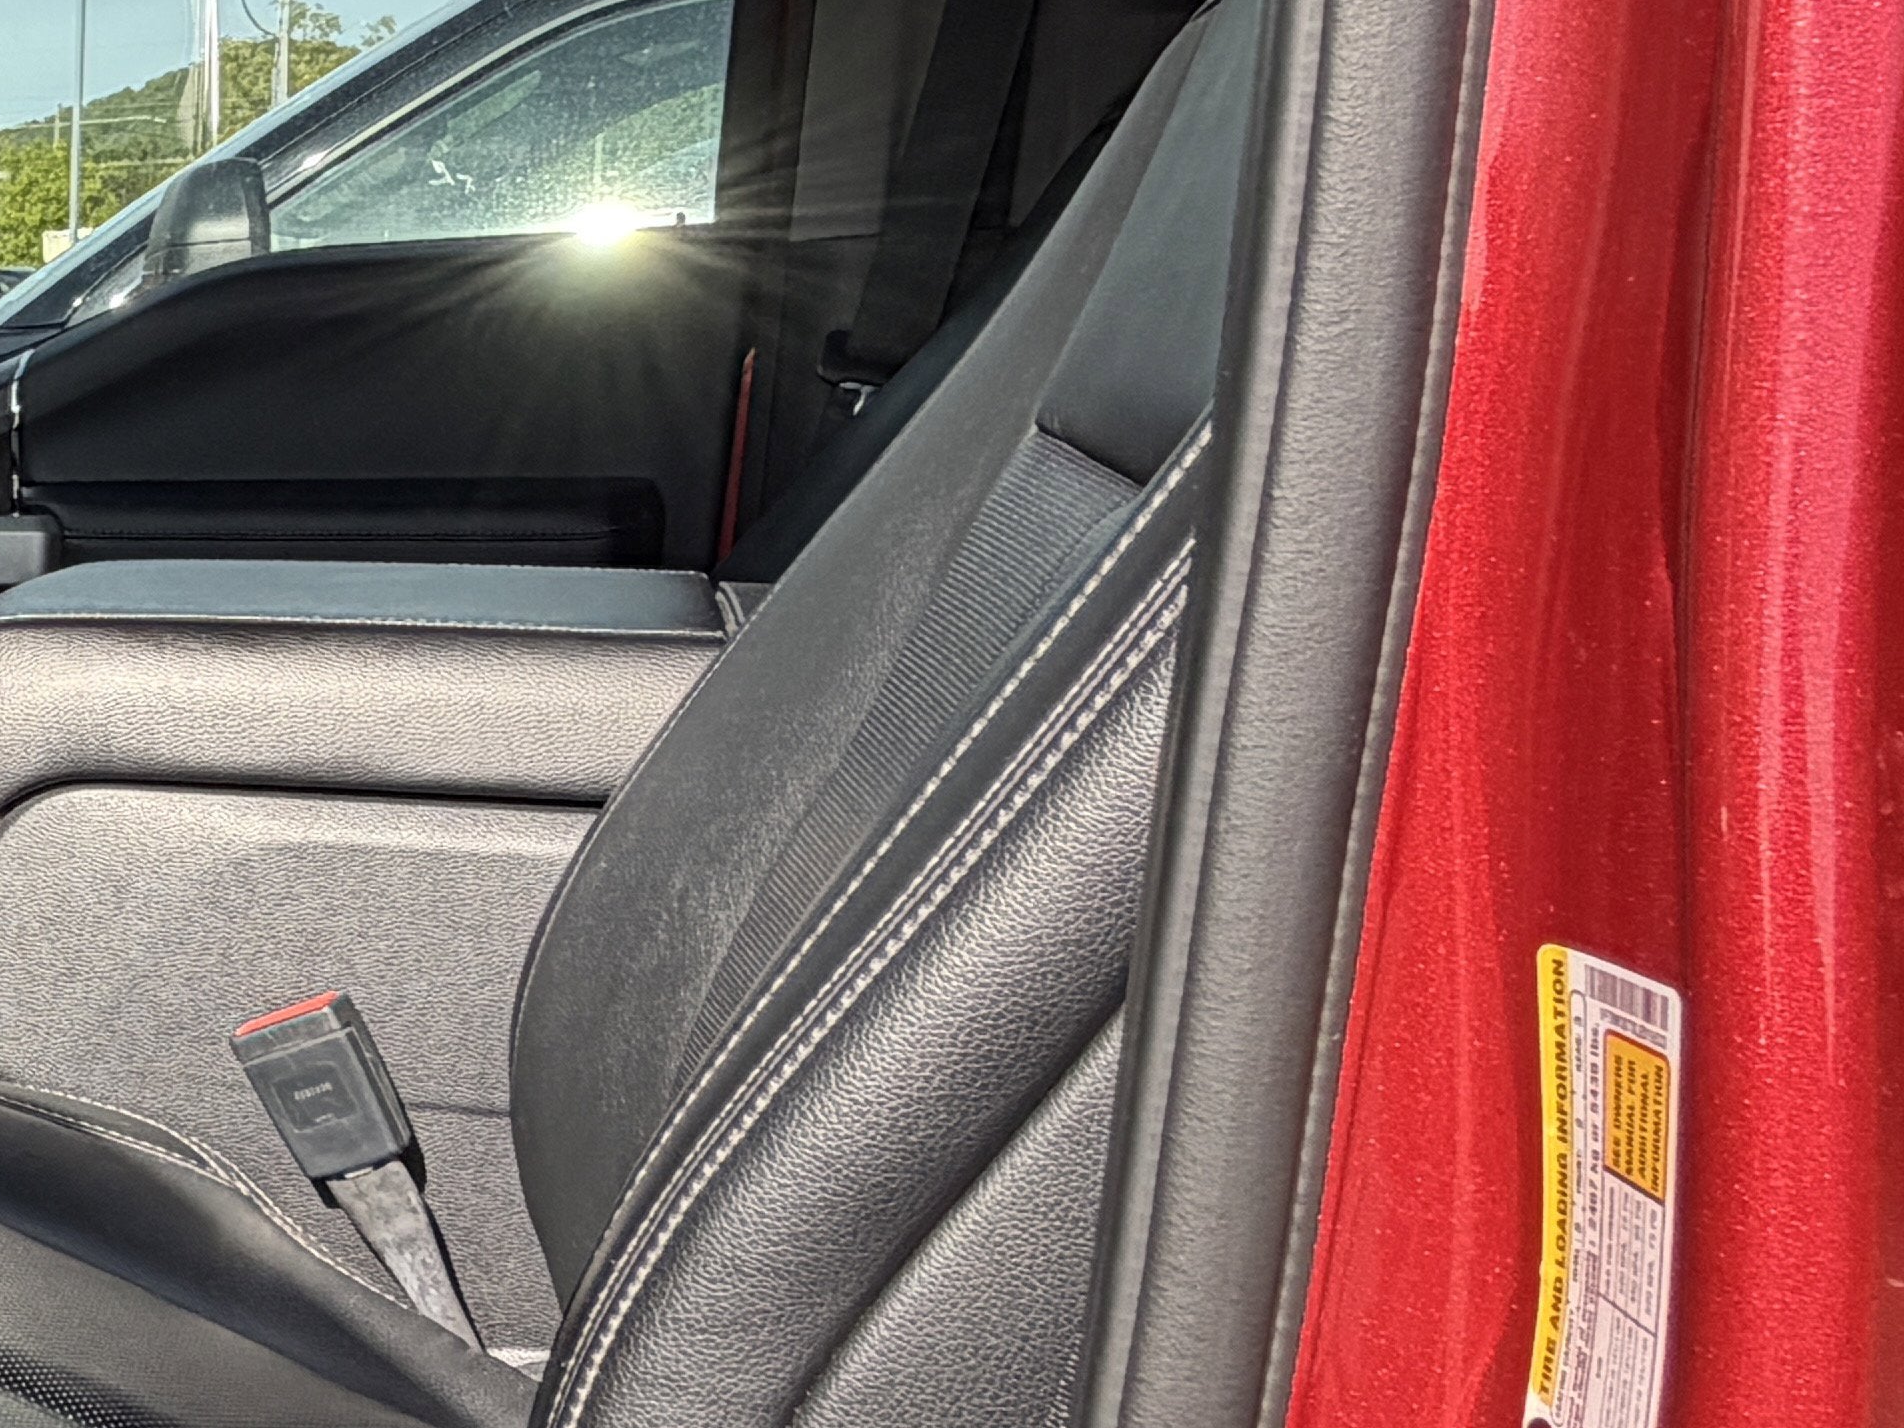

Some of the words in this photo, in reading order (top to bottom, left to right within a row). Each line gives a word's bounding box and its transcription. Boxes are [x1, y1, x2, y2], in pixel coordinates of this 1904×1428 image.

[1551, 958, 1569, 1144] INFORMATION
[1554, 1151, 1569, 1269] LOADING
[1548, 1276, 1565, 1329] AND
[1537, 1334, 1557, 1396] TIRE
